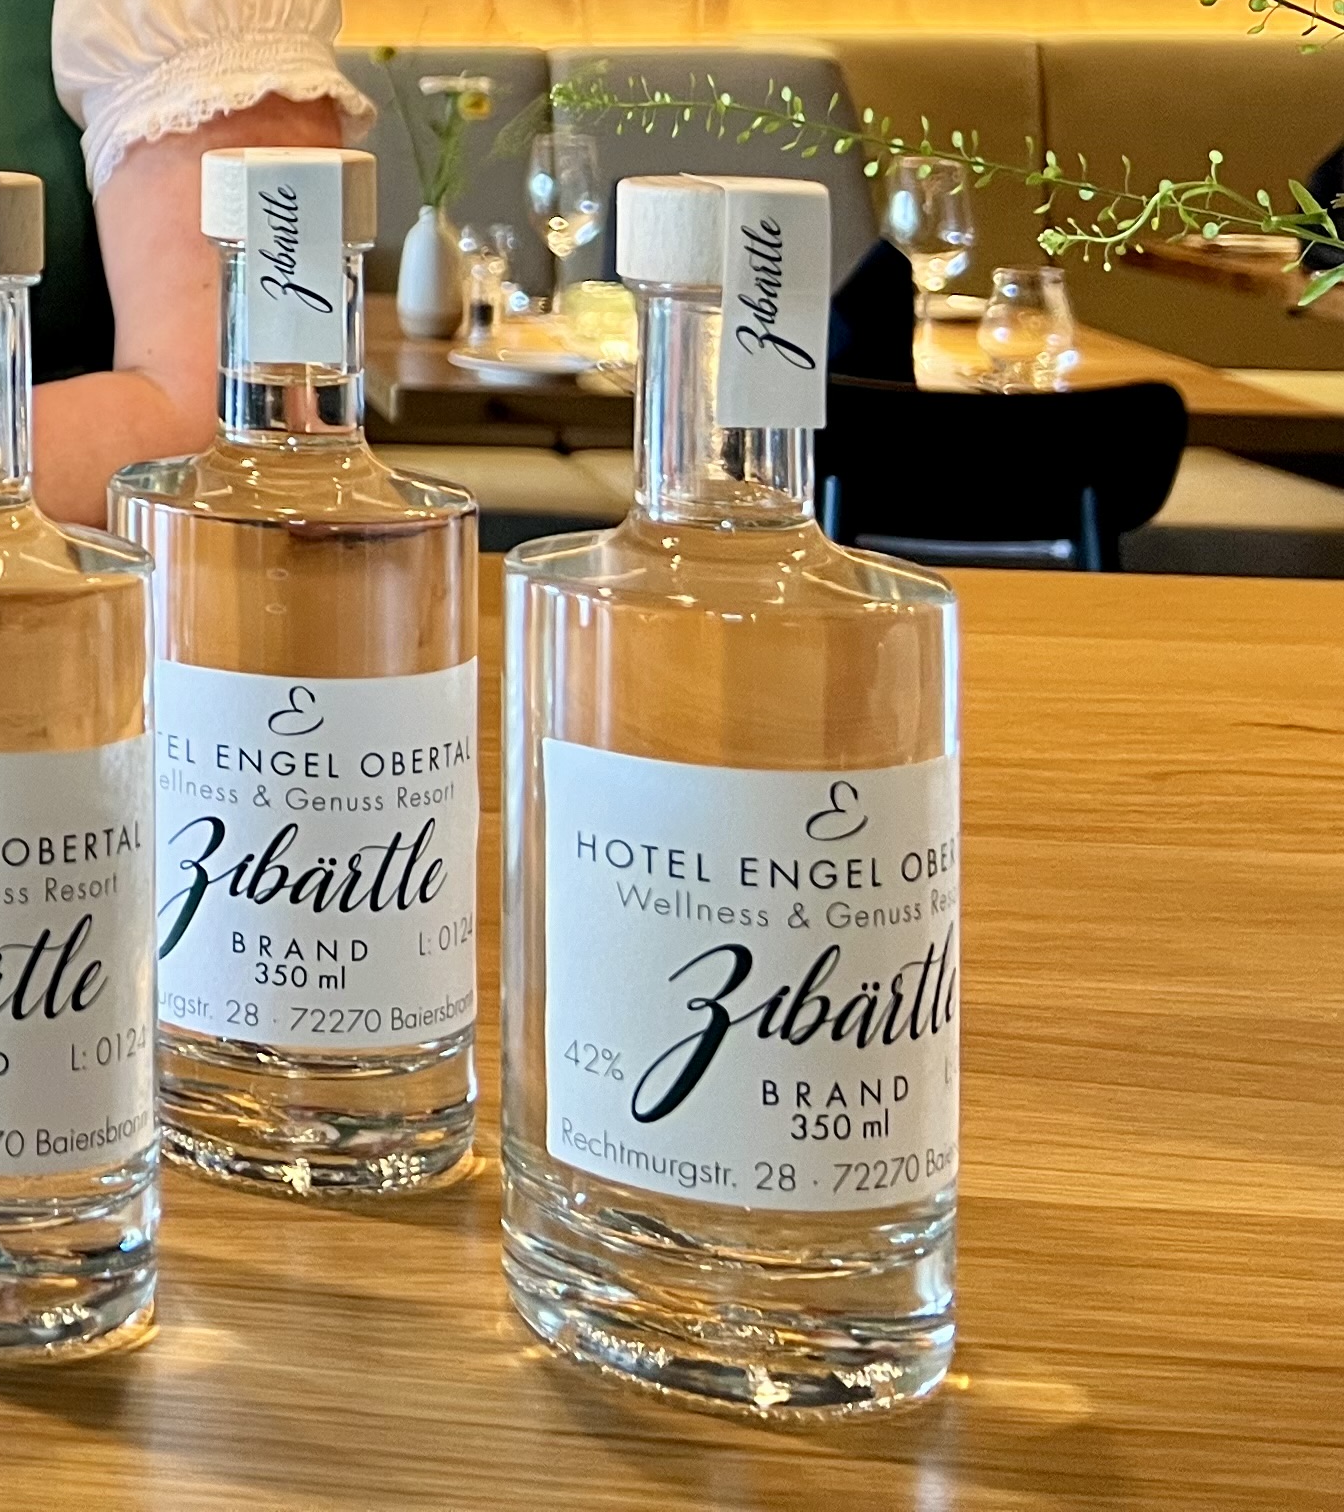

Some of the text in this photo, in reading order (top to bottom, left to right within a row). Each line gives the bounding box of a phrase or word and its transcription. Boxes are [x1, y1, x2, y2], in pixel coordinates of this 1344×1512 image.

[216, 744, 339, 778] ENGEL
[360, 735, 470, 778] OBERTAL
[252, 785, 271, 807] &
[285, 787, 384, 811] Genuss
[397, 782, 454, 808] Resort
[1, 820, 141, 866] OBERTAL
[577, 830, 710, 882] HOTEL
[740, 856, 882, 890] ENGEL
[45, 873, 117, 902] Resort
[157, 816, 448, 960] Zibärtle
[617, 881, 769, 927] Wellness
[787, 904, 810, 929] &
[826, 902, 921, 929] Genuss
[232, 931, 368, 962] BRAND
[255, 962, 345, 989] 350 ml
[226, 999, 259, 1027] 28
[290, 1007, 381, 1033] 72270
[71, 1025, 146, 1071] L: 0124
[564, 1040, 624, 1081] 42%
[762, 1076, 909, 1108] BRAND
[36, 1111, 148, 1156] Baiersbronn
[790, 1108, 889, 1140] 350 ml
[562, 1117, 737, 1189] Rechtmurgstr.
[755, 1161, 796, 1193] 28
[832, 1153, 920, 1194] 72270
